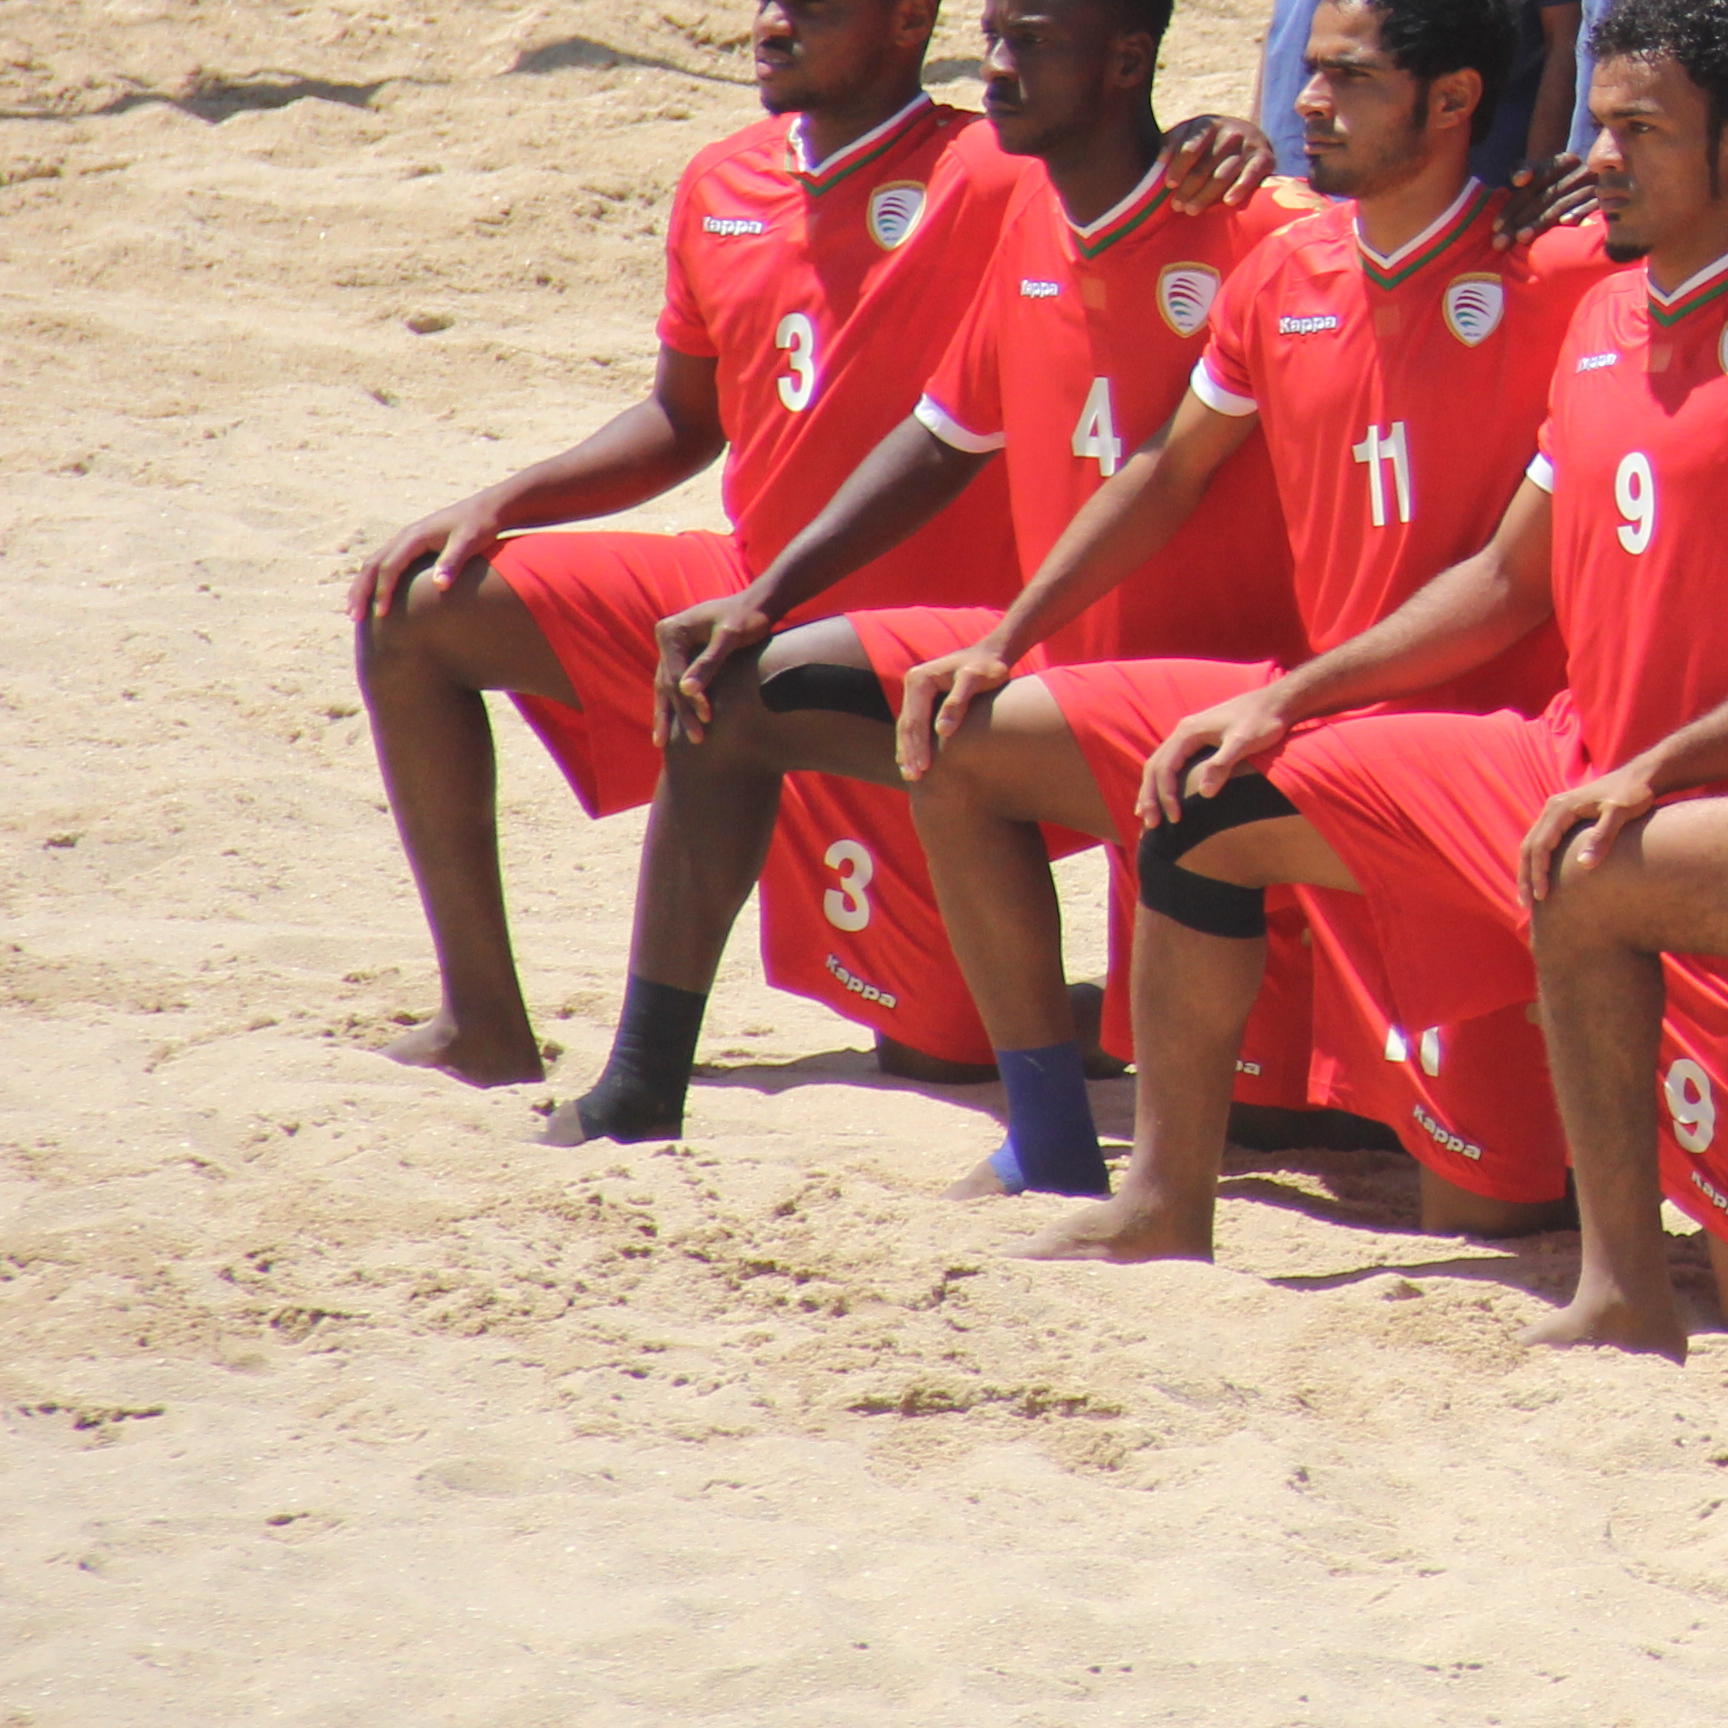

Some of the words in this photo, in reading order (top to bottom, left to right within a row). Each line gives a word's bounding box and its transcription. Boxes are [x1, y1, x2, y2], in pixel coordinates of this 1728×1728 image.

[777, 313, 814, 412] 3
[1279, 315, 1337, 335] Kappa
[1072, 377, 1121, 476] 4
[1352, 421, 1410, 526] 11
[1614, 452, 1654, 555] 9
[823, 839, 873, 932] 3
[824, 953, 897, 1009] Kappa
[1411, 1104, 1481, 1161] Kappa
[1664, 1058, 1716, 1153] 9
